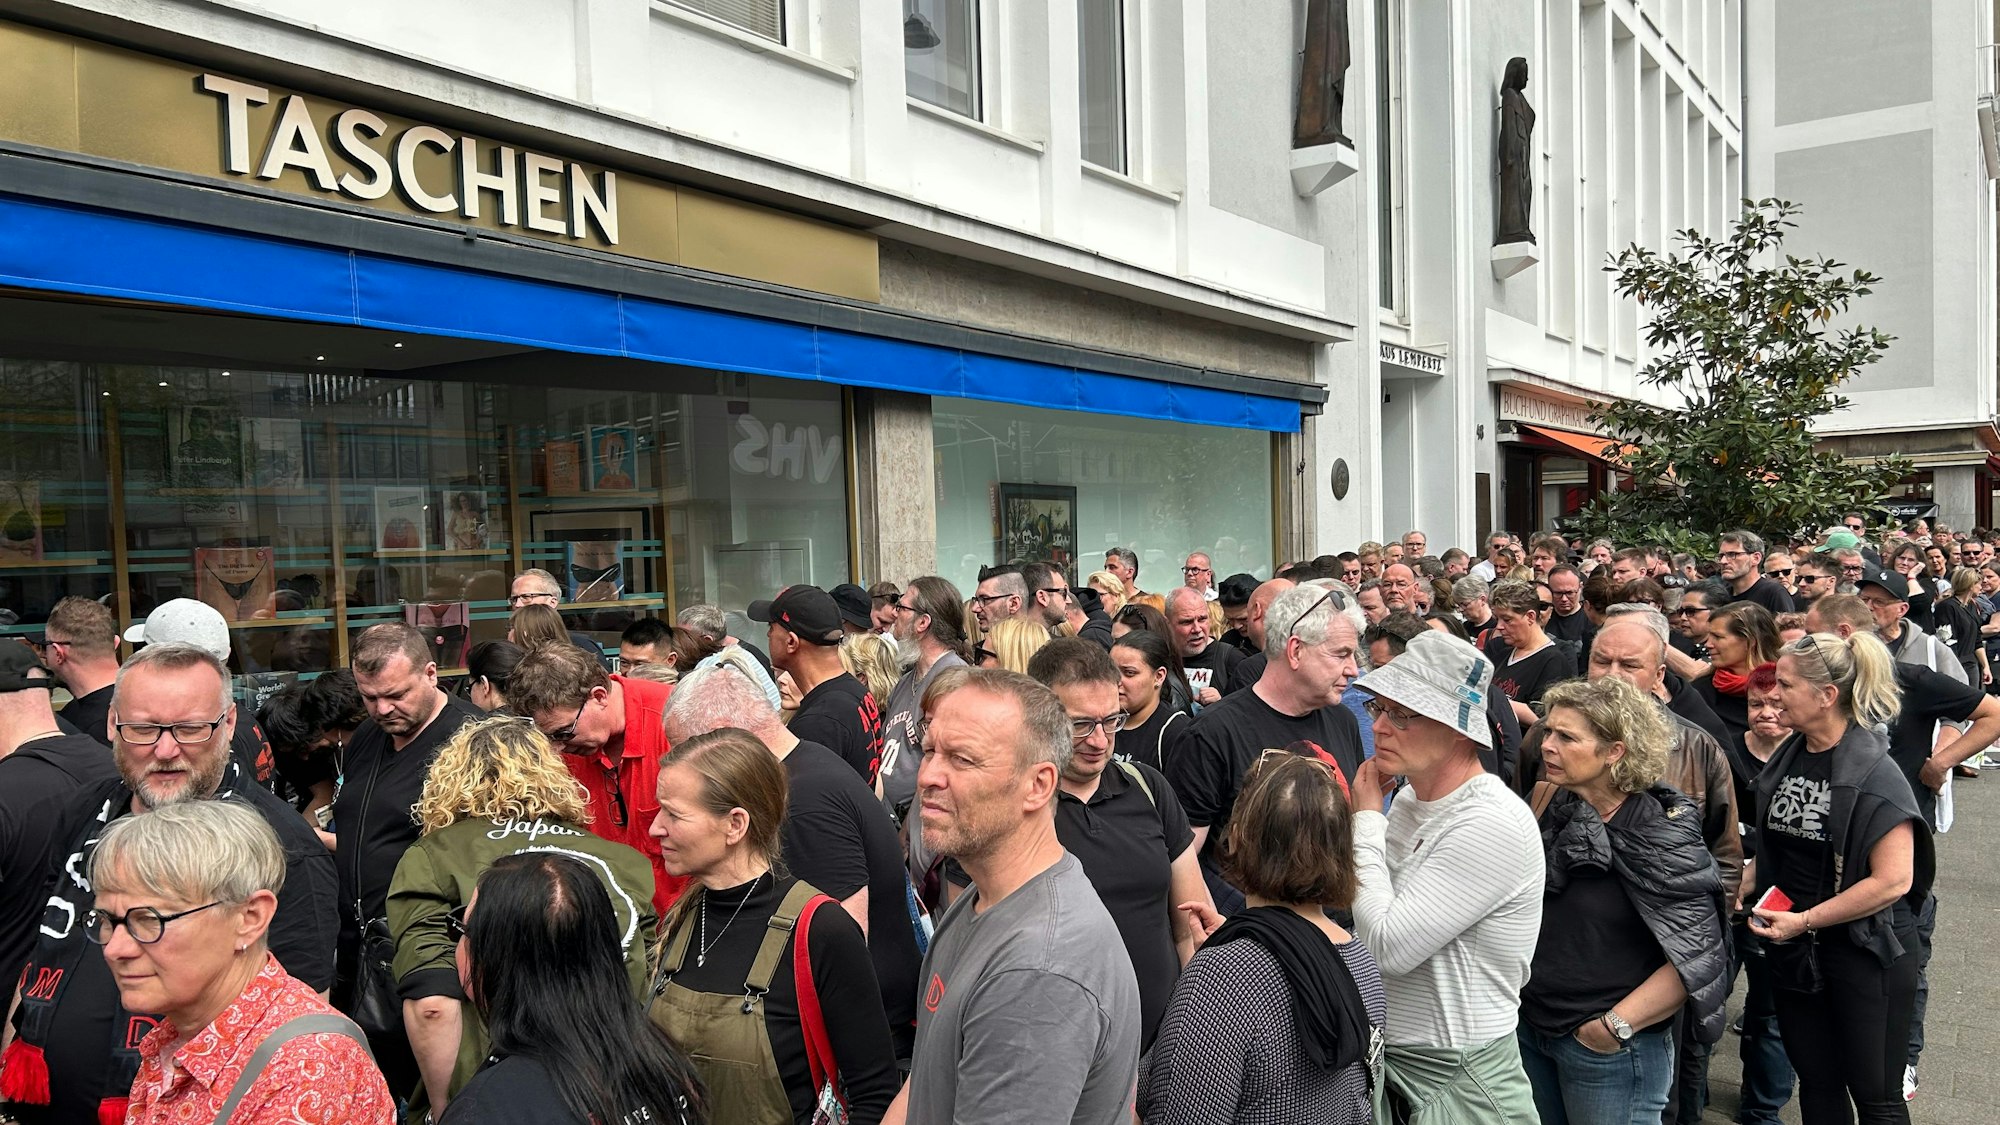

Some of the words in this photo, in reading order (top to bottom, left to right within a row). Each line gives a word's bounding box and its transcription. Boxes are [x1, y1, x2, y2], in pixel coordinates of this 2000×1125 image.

[199, 73, 619, 245] TASCHEN
[1380, 344, 1395, 360] AUS
[1399, 349, 1442, 372] LEMPERTZ
[195, 456, 232, 465] Lindbergh
[487, 818, 585, 841] Japan
